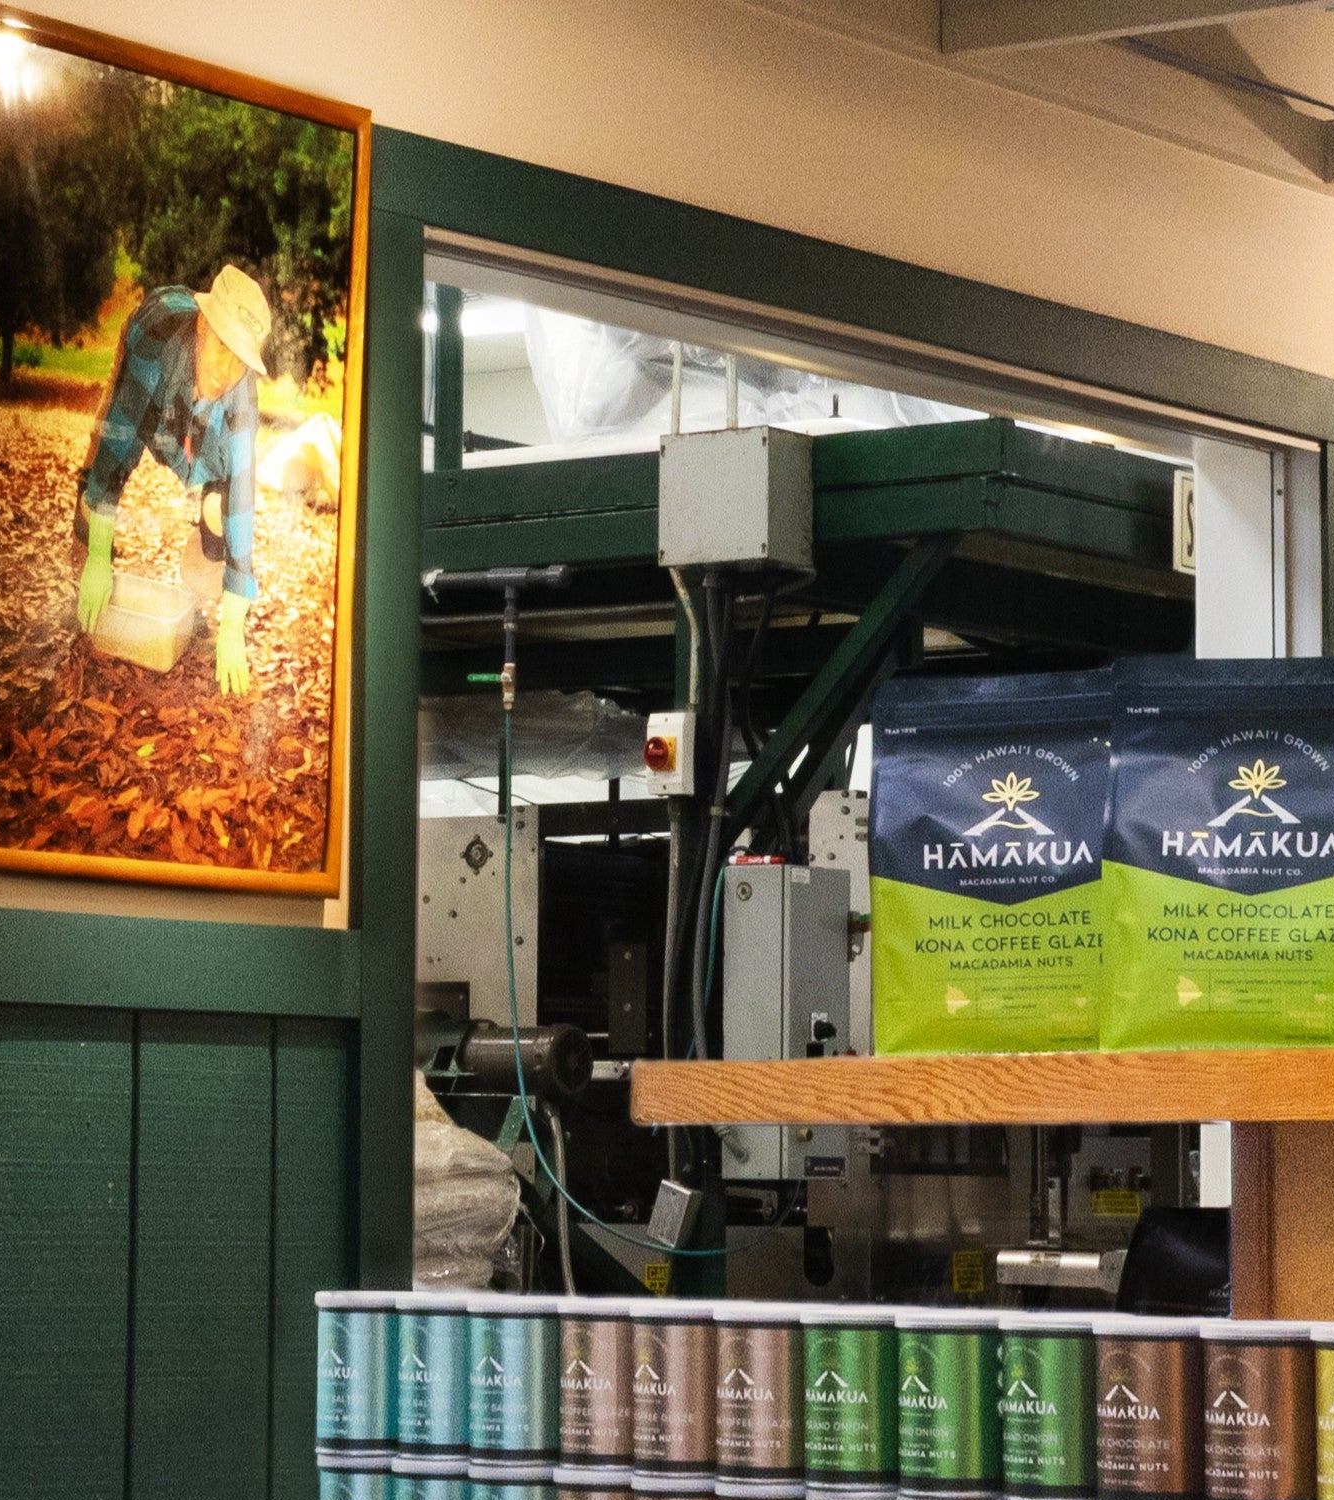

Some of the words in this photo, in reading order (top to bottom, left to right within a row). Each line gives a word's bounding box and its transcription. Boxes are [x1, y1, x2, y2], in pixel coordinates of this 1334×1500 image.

[943, 763, 973, 788] 100%
[1035, 749, 1079, 782] GROWN
[959, 877, 1016, 886] MACADAMIA
[1019, 876, 1038, 884] NUT
[1163, 903, 1208, 918] MILK
[1217, 903, 1334, 919] CHOCOLATE
[929, 915, 972, 929] MILK
[980, 911, 1091, 928] CHOCOLATE
[1147, 927, 1199, 942] KONA
[1207, 928, 1280, 943] COFFEE
[915, 939, 965, 953] KONA
[972, 936, 1041, 951] COFFEE
[1184, 950, 1269, 961] MACADAMIA
[1275, 950, 1313, 961] NUTS
[949, 958, 1031, 971] MACADAMIA
[1037, 957, 1073, 967] NUTS
